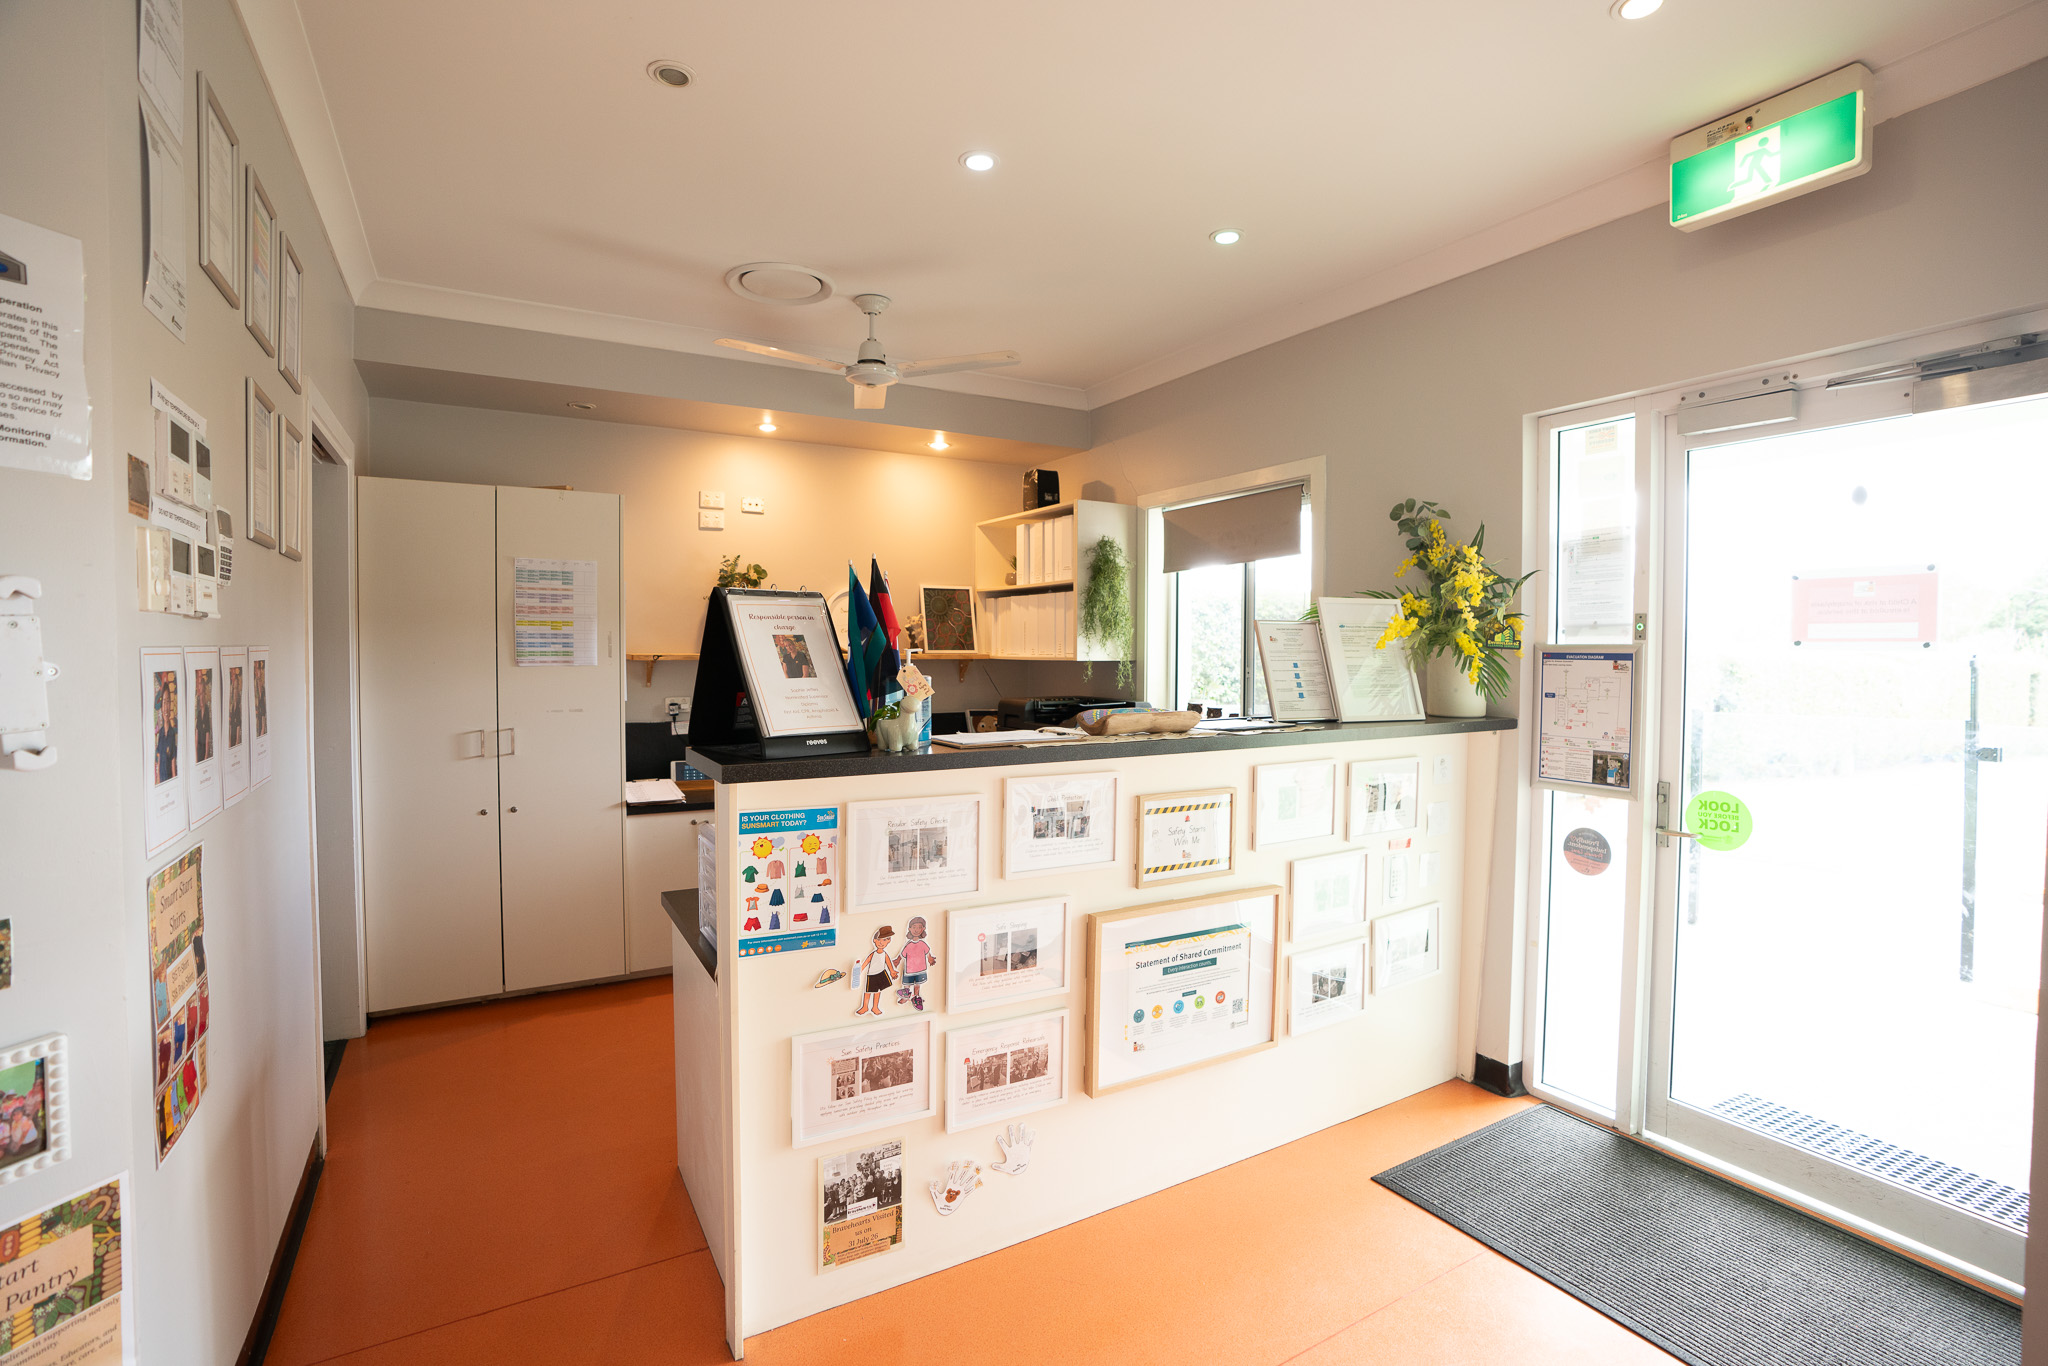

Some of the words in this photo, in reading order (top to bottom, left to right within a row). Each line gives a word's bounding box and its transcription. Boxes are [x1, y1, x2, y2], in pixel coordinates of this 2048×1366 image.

[30, 317, 39, 326] in
[42, 321, 58, 331] this
[43, 331, 58, 341] the
[40, 339, 58, 350] The
[50, 351, 58, 360] in
[43, 359, 59, 369] Act
[22, 396, 41, 405] and
[43, 400, 63, 410] may
[52, 391, 63, 401] by
[11, 402, 47, 416] Service
[49, 409, 63, 418] for
[748, 613, 785, 621] Responsible
[806, 738, 828, 746] reeves
[750, 814, 770, 822] YOUR
[771, 812, 806, 821] CLOTHING
[887, 820, 906, 831] Regular
[910, 818, 928, 828] Safety
[930, 817, 949, 825] Checks
[741, 821, 780, 830] SUNSMART
[781, 819, 807, 827] TODAY?
[1168, 826, 1186, 839] Safety
[160, 887, 178, 914] Smart
[179, 877, 193, 899] Start
[169, 910, 187, 935] Shirts
[1135, 956, 1170, 970] Statement
[1171, 953, 1179, 962] of
[1179, 950, 1203, 961] Shared
[1203, 942, 1242, 956] Commitment
[1167, 966, 1178, 974] Every
[1179, 962, 1199, 971] interaction
[841, 1049, 852, 1057] Sun
[855, 1045, 873, 1054] Safety
[972, 1046, 998, 1056] Emergency
[1000, 1041, 1020, 1050] Response
[832, 1218, 871, 1234] Bravehearts
[872, 1210, 894, 1222] Visited
[848, 1240, 855, 1248] 31
[856, 1236, 870, 1246] July
[870, 1233, 879, 1241] 26
[6, 1266, 78, 1312] Pantry
[32, 1340, 41, 1349] in
[43, 1314, 87, 1342] supporting
[88, 1305, 102, 1317] not
[102, 1297, 120, 1309] only
[102, 1323, 118, 1337] and
